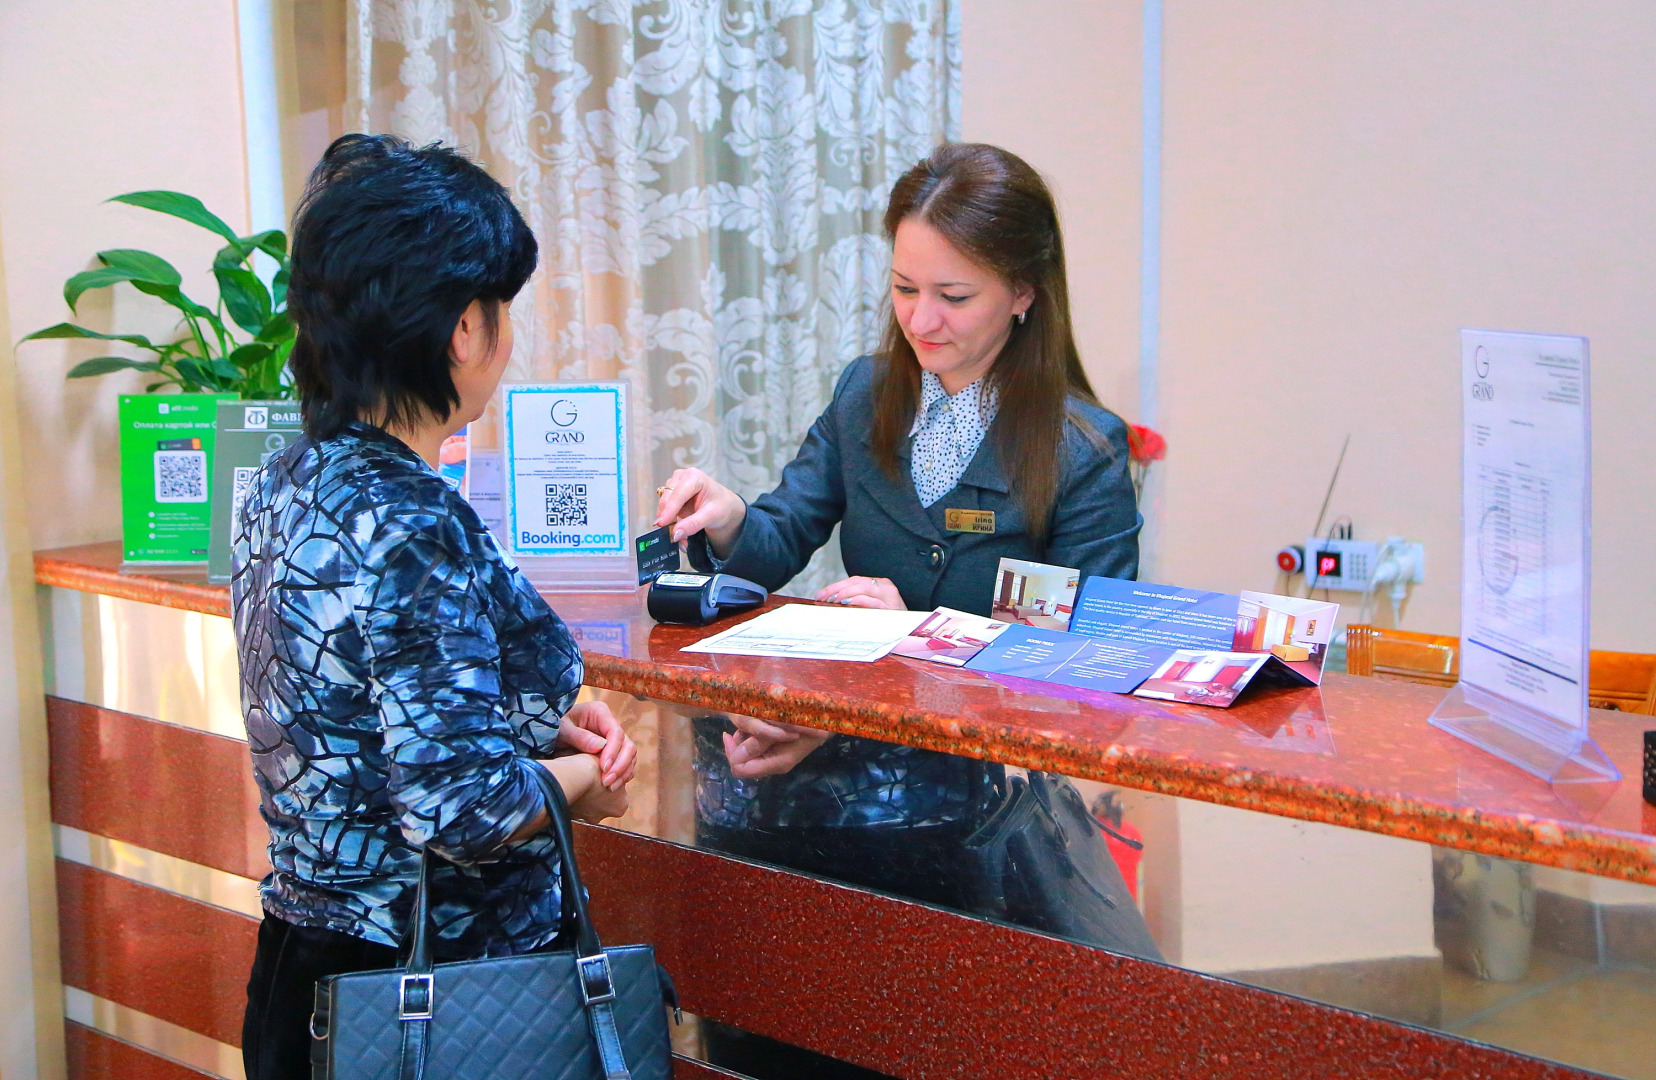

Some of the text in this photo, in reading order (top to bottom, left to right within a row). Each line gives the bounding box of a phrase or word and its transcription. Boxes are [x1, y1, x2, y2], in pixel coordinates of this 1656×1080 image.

[1472, 384, 1494, 400] GRAND
[545, 432, 585, 444] GRAND
[522, 531, 616, 546] Booking.com
